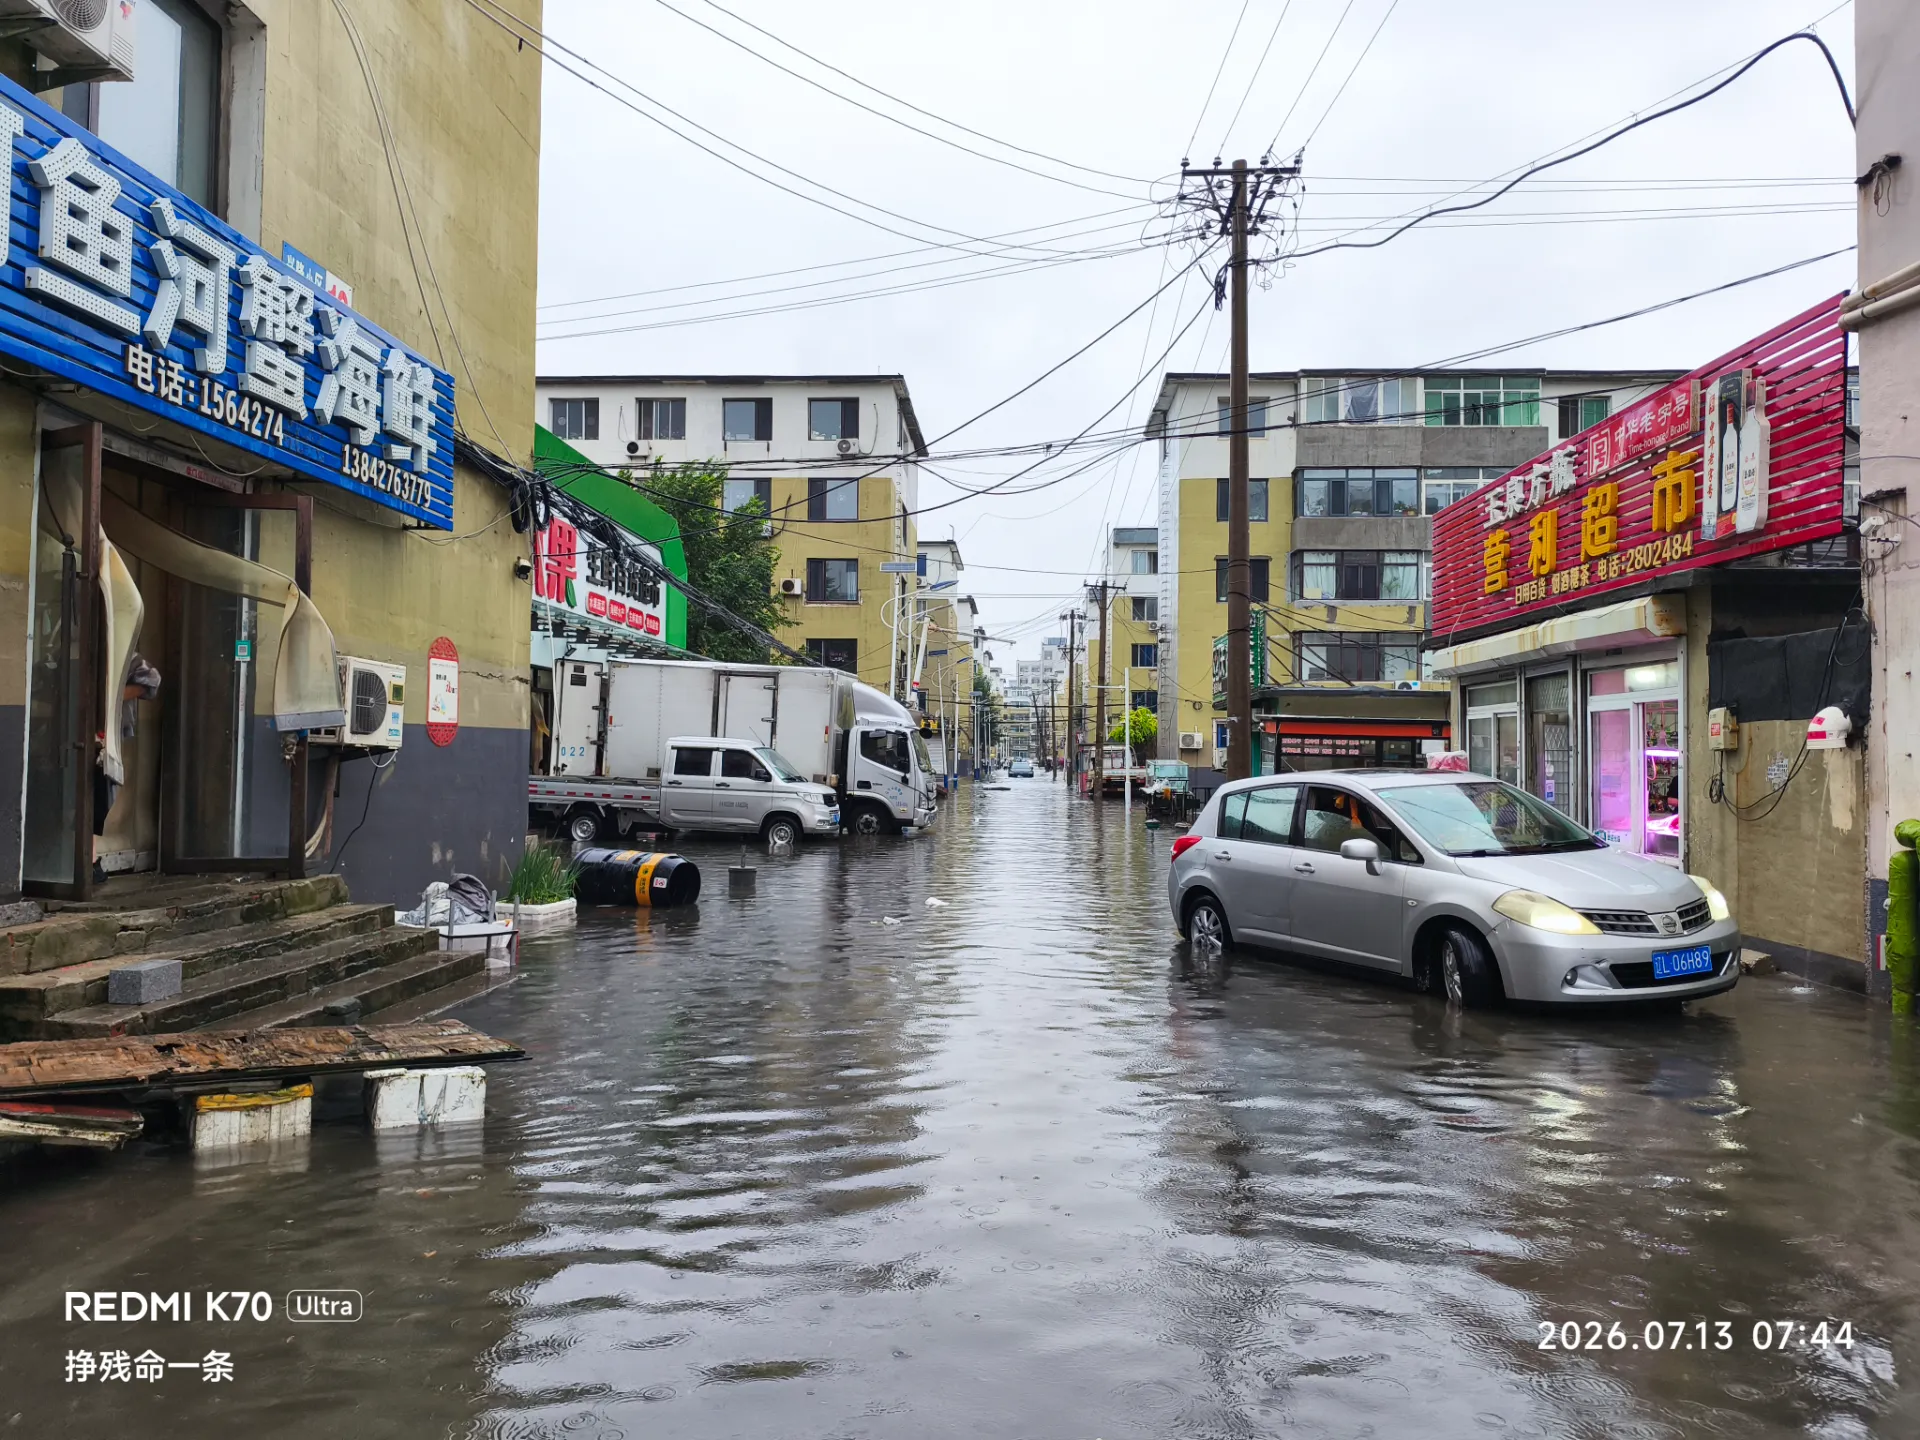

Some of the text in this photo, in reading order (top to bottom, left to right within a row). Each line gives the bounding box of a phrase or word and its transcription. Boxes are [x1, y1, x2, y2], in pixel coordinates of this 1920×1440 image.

[0, 104, 437, 473] 鱼河蟹海鲜
[1614, 392, 1690, 448] 中华老字号
[1670, 419, 1689, 437] Brand
[342, 443, 432, 509] 13842763779
[1483, 450, 1698, 594] 营利超市
[534, 516, 577, 608] 果
[1515, 577, 1546, 605] 日用百货
